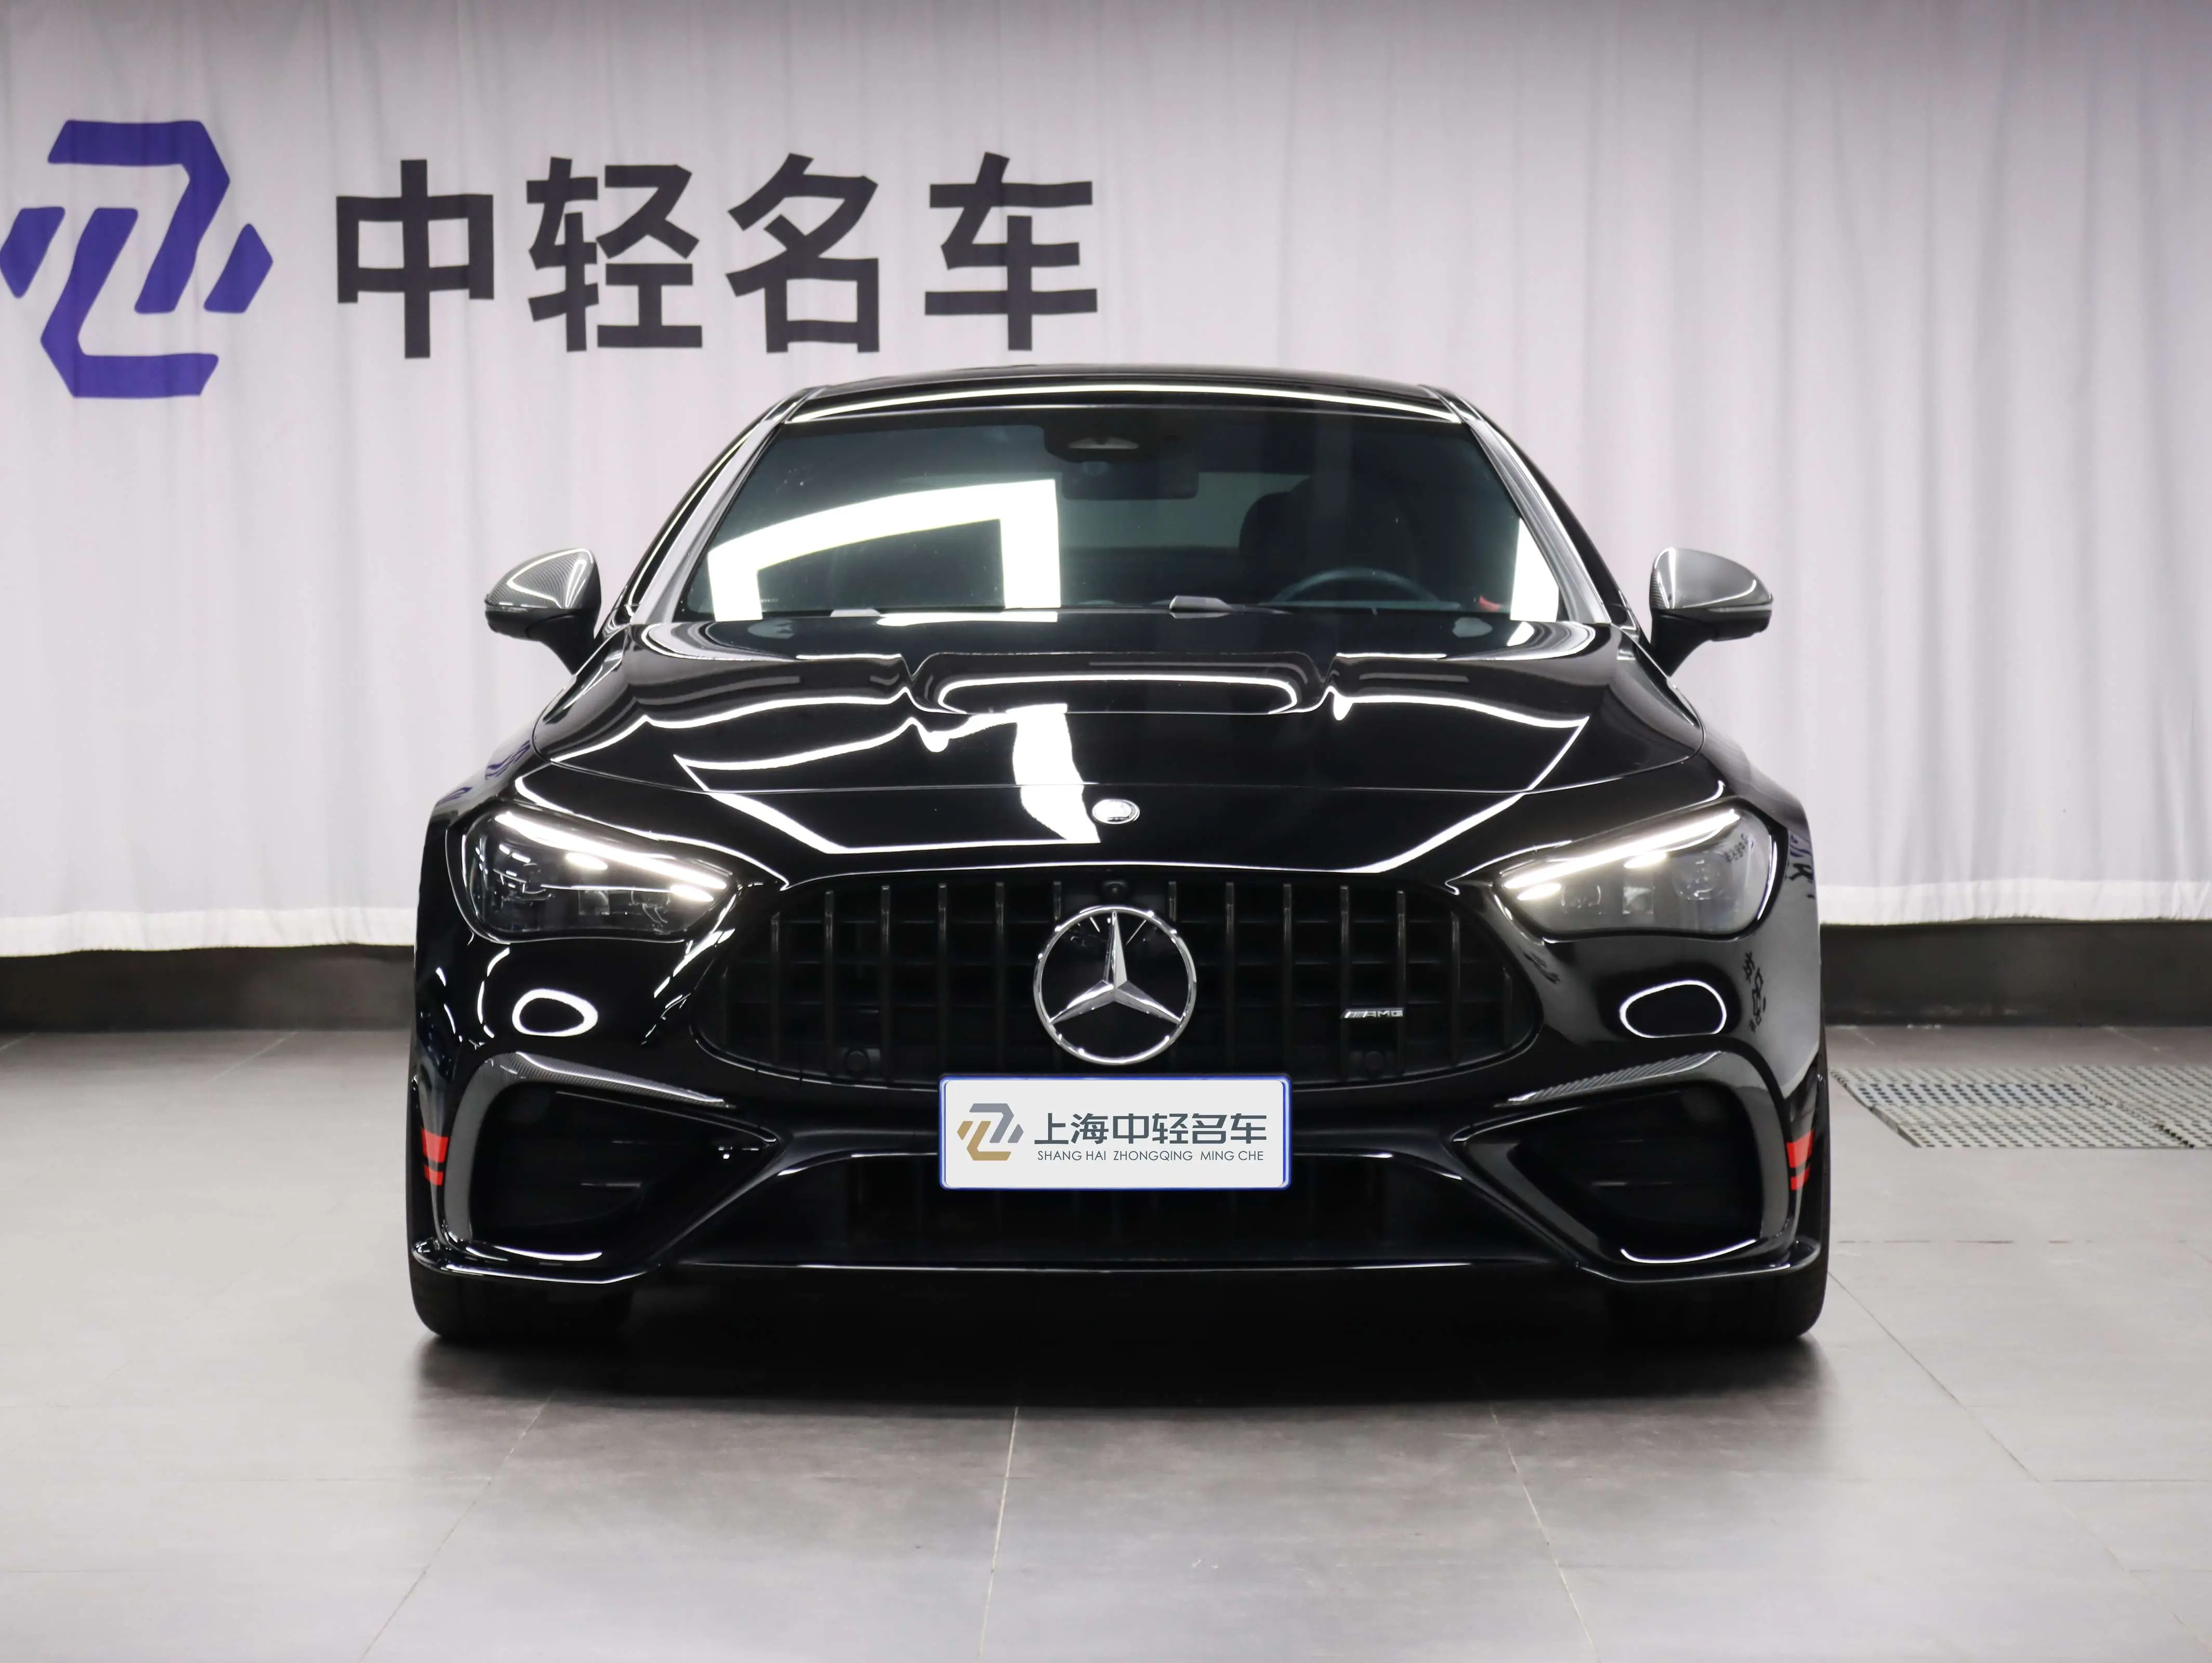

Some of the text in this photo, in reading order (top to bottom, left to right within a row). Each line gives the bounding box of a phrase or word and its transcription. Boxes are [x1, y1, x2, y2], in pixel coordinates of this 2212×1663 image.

[336, 152, 1097, 359] 中轻名车
[1363, 1009, 1403, 1018] AMG
[1034, 1113, 1267, 1144] 上海中轻名车
[1037, 1151, 1263, 1161] SHANG HAI ZHONGQING MING CHE
